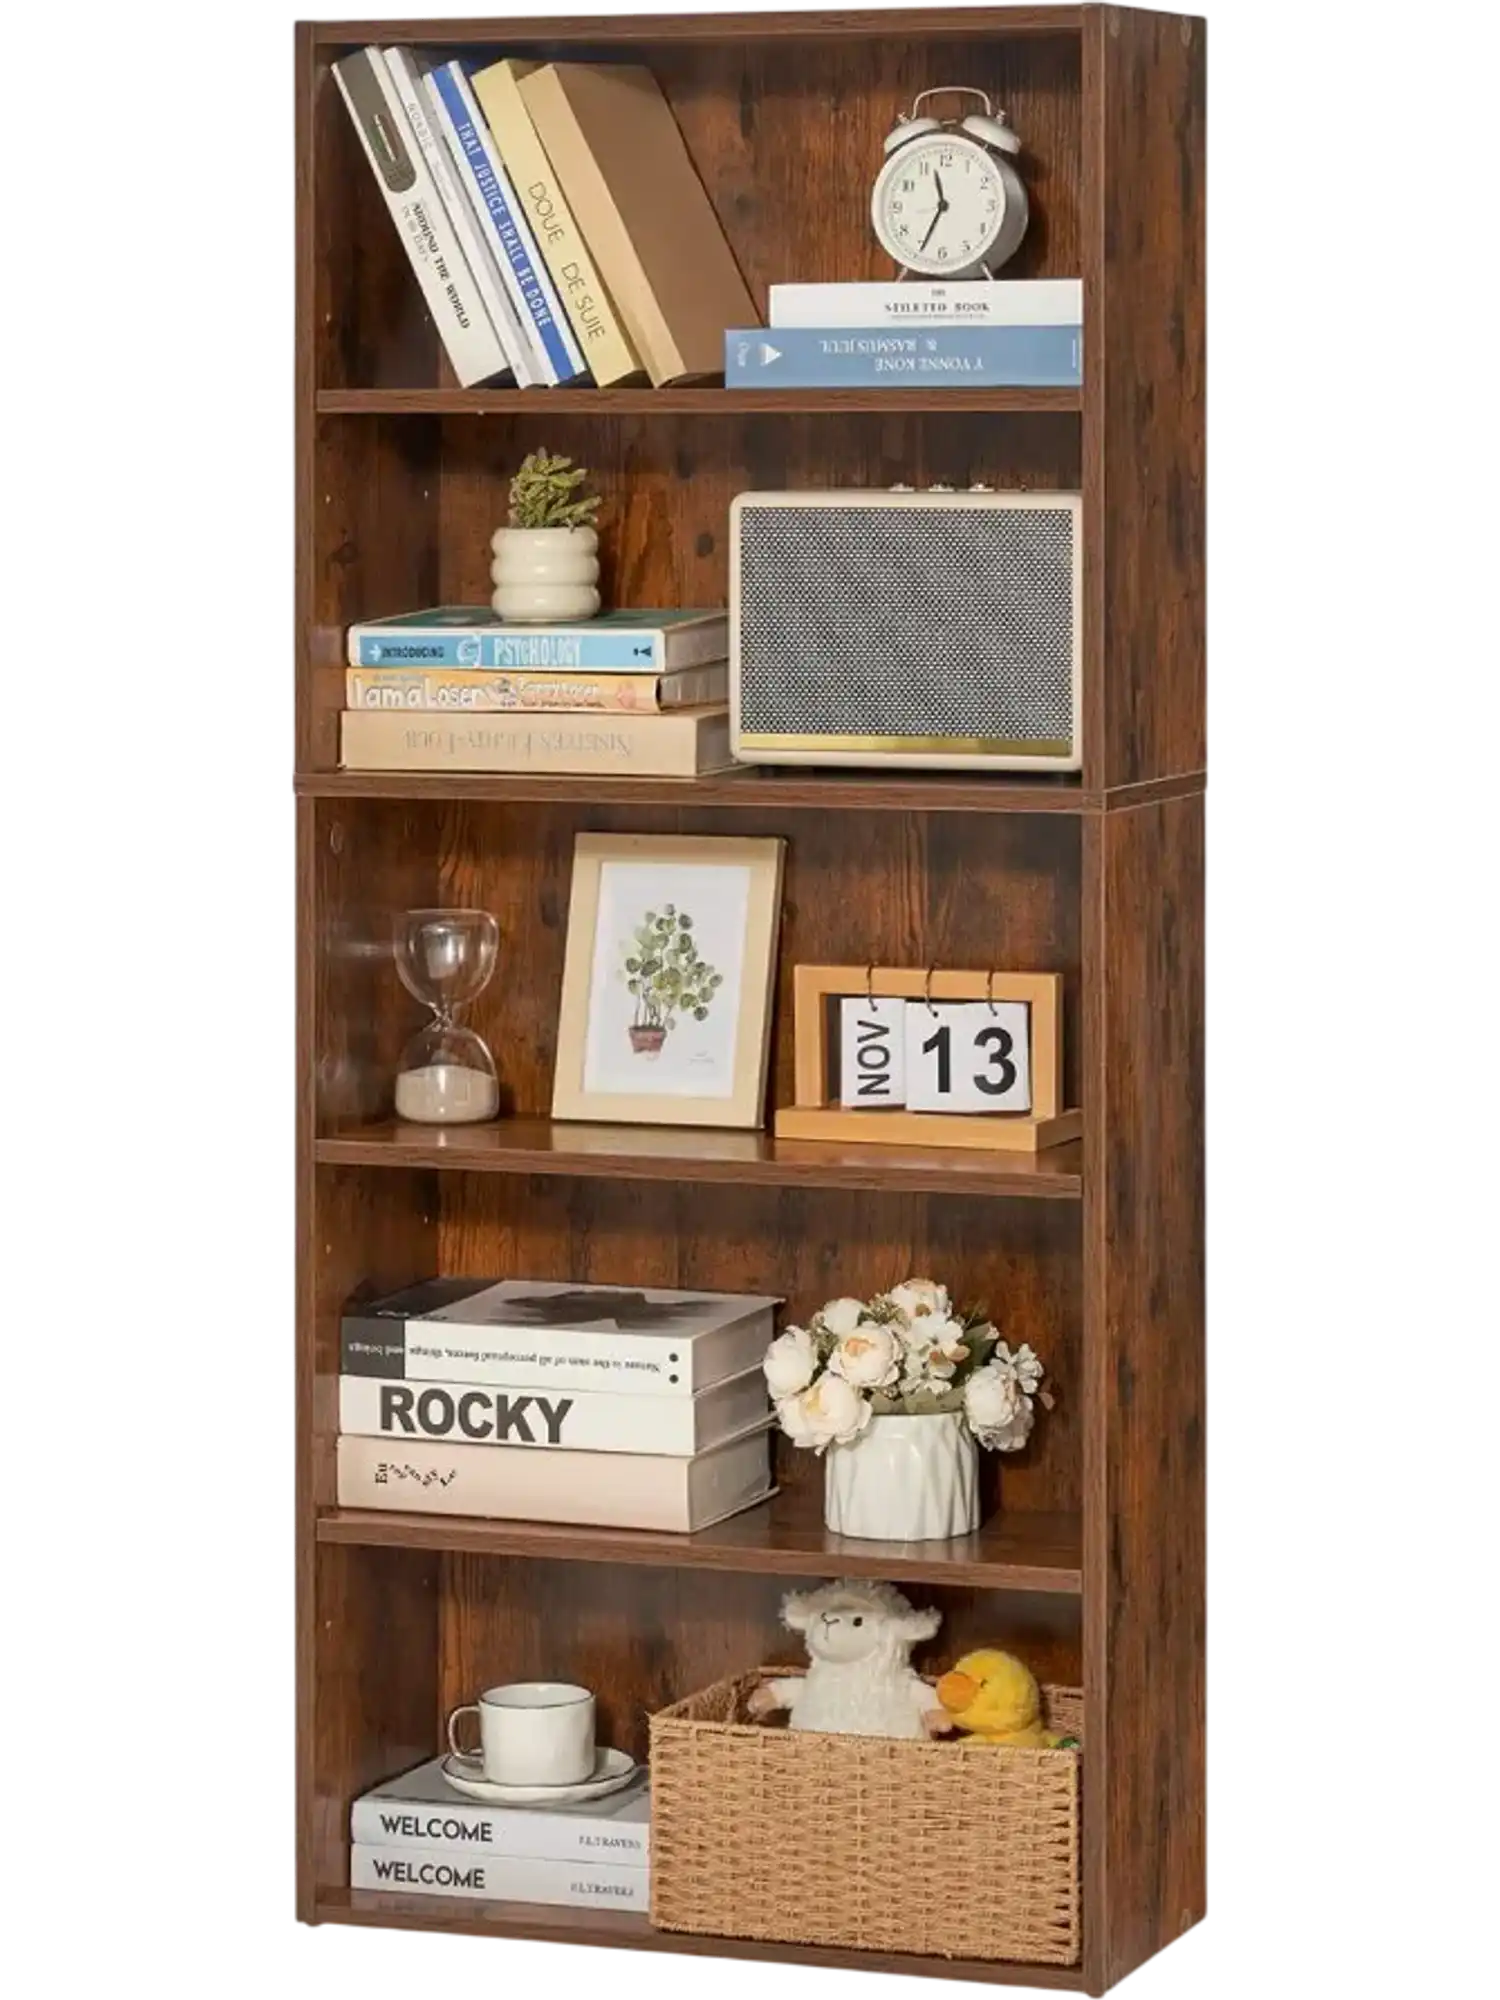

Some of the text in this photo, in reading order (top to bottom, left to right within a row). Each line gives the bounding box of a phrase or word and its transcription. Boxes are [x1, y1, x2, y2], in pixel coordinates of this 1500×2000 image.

[459, 123, 551, 326] THAT JUSTICE SHALL BE DONE
[434, 256, 450, 280] THE
[447, 284, 470, 328] WORLD
[561, 263, 586, 294] DE
[575, 296, 606, 341] SUIE
[955, 302, 991, 313] BOOK
[857, 338, 917, 352] RASMUS
[381, 645, 445, 658] INTRODUCING
[493, 636, 581, 667] PSYCHOLOGY
[857, 1020, 890, 1096] NOV
[922, 1026, 1018, 1096] 13
[379, 1385, 573, 1444] ROCKY
[380, 1814, 493, 1842] WELCOME
[373, 1860, 485, 1889] WELCOME
